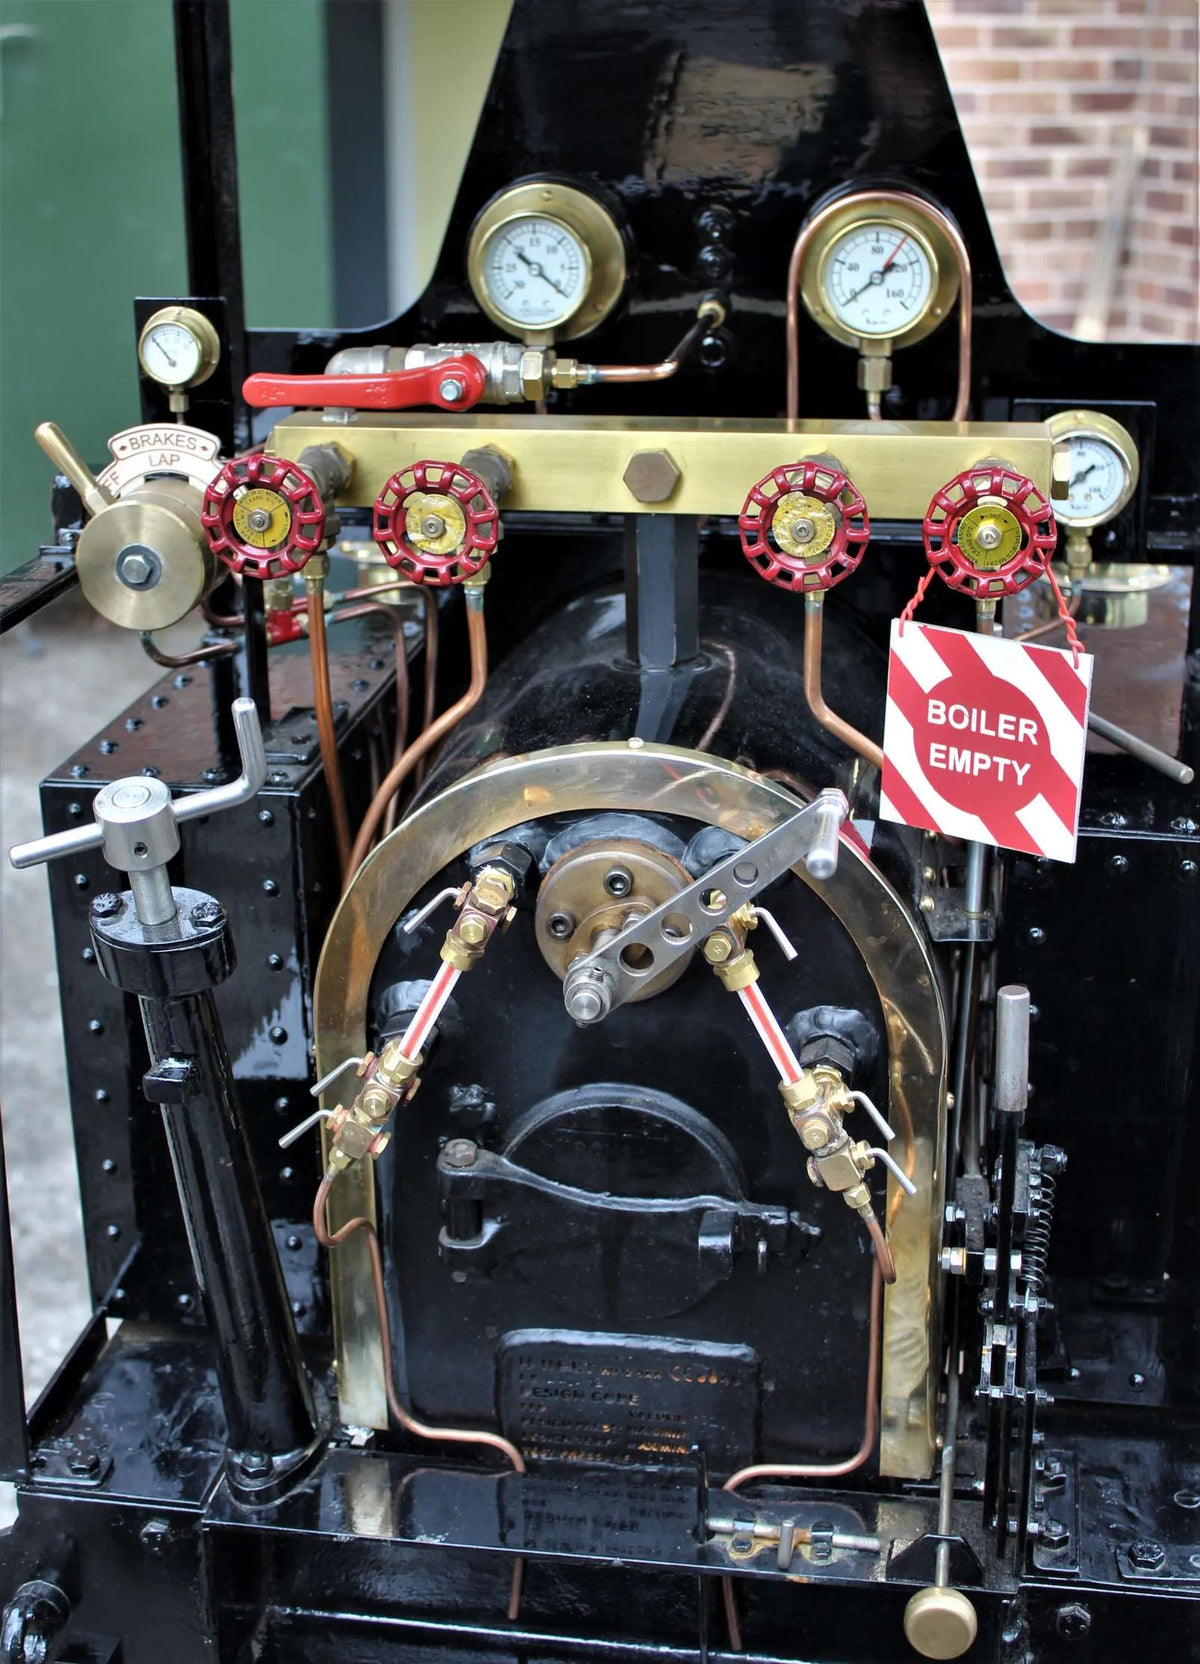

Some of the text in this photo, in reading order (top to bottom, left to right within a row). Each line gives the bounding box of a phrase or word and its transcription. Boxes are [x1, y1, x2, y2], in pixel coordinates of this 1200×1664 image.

[529, 238, 540, 247] 15
[546, 245, 558, 254] 10
[871, 246, 884, 255] 80
[506, 263, 517, 273] 25
[847, 263, 860, 272] 40
[885, 288, 905, 298] 160
[129, 432, 198, 451] BRAKES
[148, 453, 180, 467] LAP
[927, 699, 1039, 746] BOILER
[929, 742, 1031, 787] EMPTY
